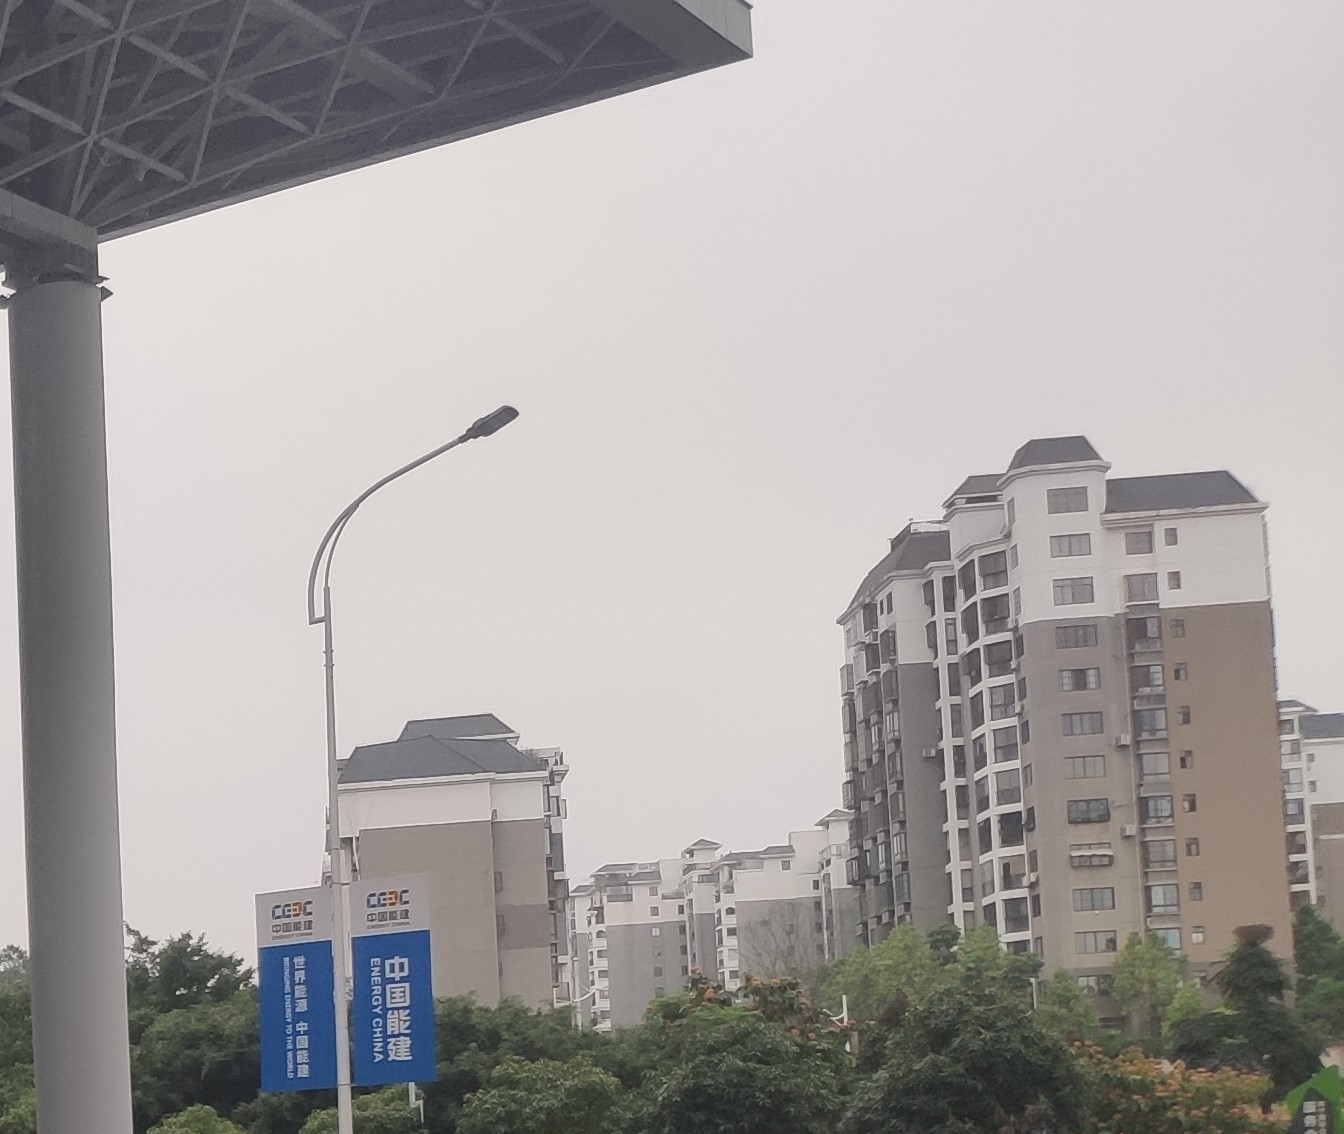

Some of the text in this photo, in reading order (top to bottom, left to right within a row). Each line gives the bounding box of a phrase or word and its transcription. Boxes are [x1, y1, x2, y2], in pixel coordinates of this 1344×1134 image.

[369, 957, 385, 1064] ENERGY CHINA
[384, 955, 413, 1062] 中国能建
